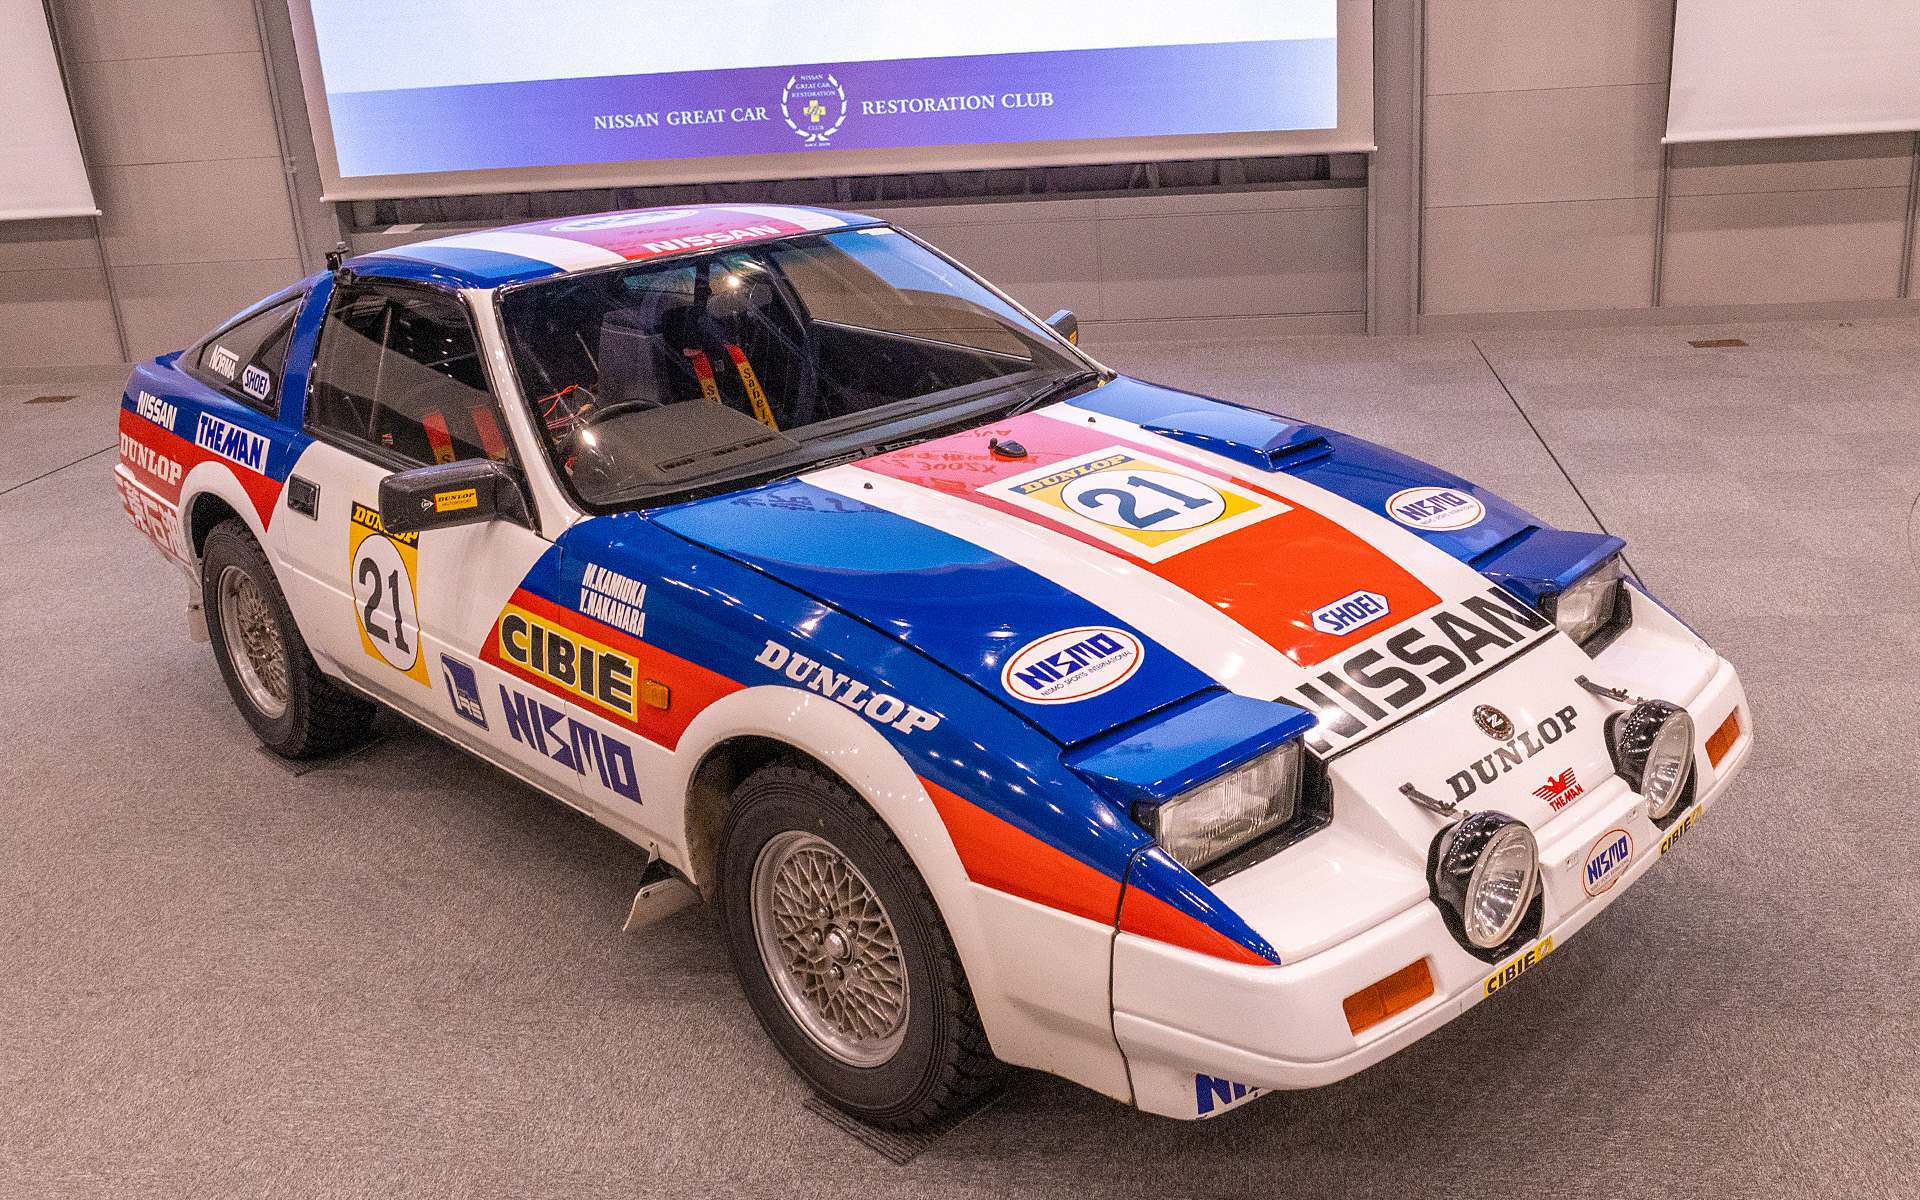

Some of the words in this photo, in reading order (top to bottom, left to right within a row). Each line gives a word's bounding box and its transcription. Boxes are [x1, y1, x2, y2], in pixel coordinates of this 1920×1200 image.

[792, 90, 836, 98] RESTORATION
[861, 94, 995, 115] RESTORATION
[1001, 92, 1054, 108] CLUB
[593, 112, 659, 130] NISSAN
[666, 109, 726, 126] GREAT
[730, 106, 770, 122] CAR
[642, 225, 782, 253] NISSAN
[209, 345, 236, 381] NORMA
[245, 370, 268, 396] SHOEI
[136, 390, 178, 431] NISSAN
[119, 431, 182, 486] DUNLOP
[1020, 455, 1125, 493] DUNLOP
[438, 492, 475, 502] DUNLOP
[1077, 475, 1214, 530] 21
[1396, 492, 1468, 521] NISMO
[358, 556, 411, 655] 21
[582, 562, 647, 609] M.KAMIOKA
[579, 587, 646, 638] Y.NAKAHARA
[1319, 594, 1384, 631] SHOEI
[1014, 632, 1125, 691] NISMO
[1041, 683, 1064, 697] NISMO
[1065, 671, 1088, 685] SPORTS
[1089, 650, 1133, 673] INTERNATIONAL
[1272, 586, 1552, 755] NISSAN
[754, 639, 940, 735] DUNLOP
[498, 683, 643, 805] NISMO
[1445, 705, 1578, 803] DUNLOP
[1587, 835, 1628, 885] NISMO
